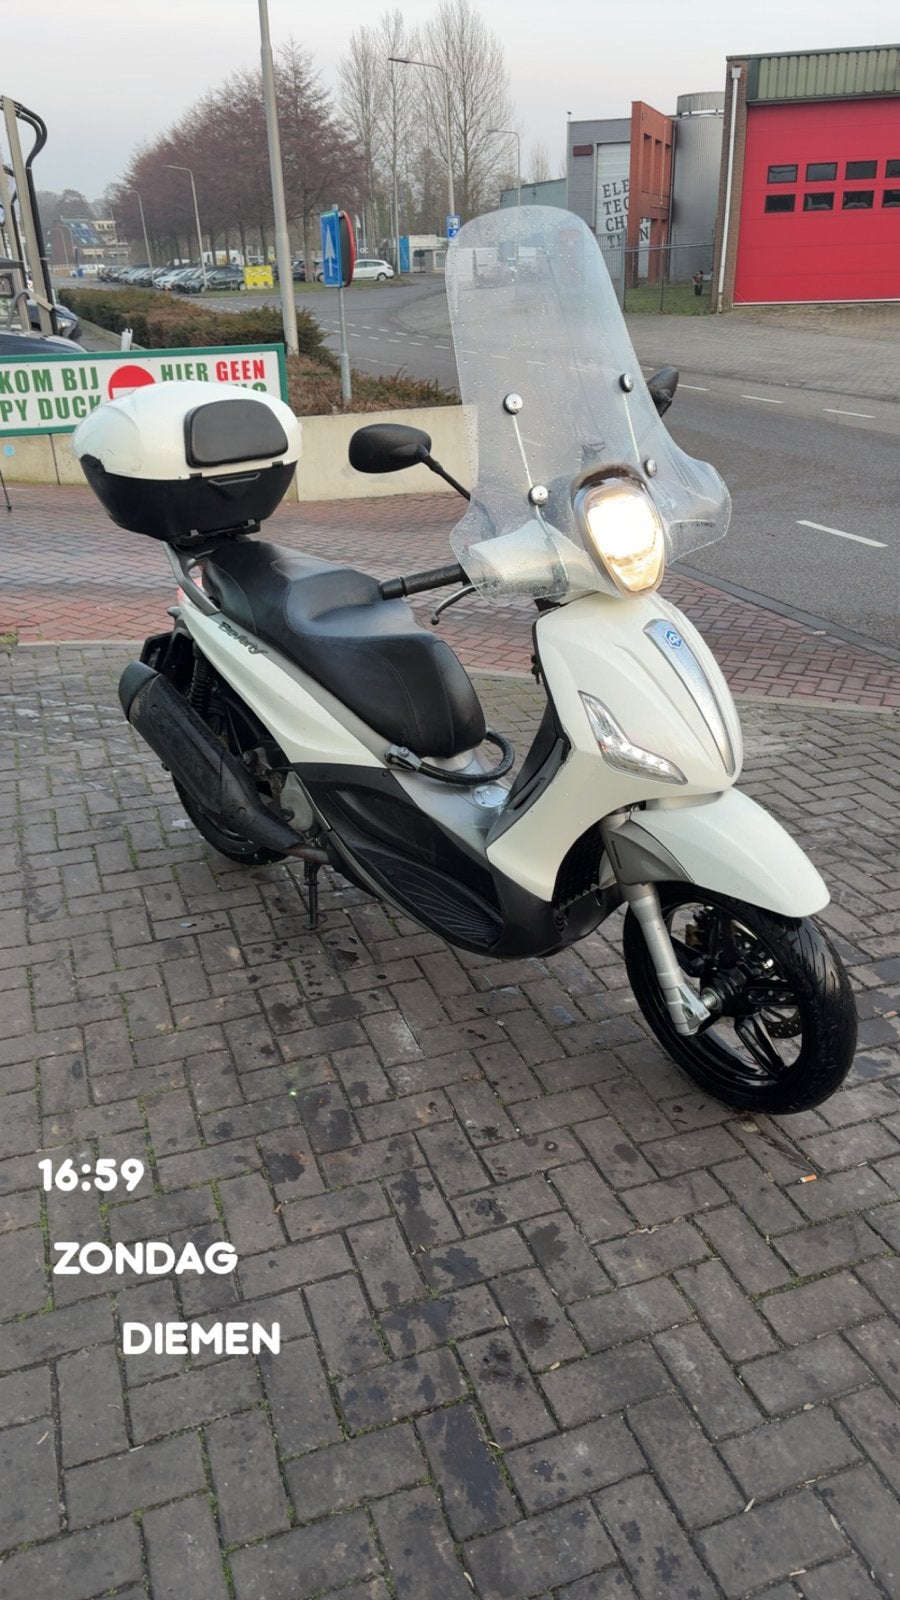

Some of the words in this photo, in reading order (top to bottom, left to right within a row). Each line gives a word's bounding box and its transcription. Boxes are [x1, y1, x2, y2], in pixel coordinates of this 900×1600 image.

[605, 214, 628, 232] CH
[0, 369, 54, 394] KOM
[61, 367, 99, 391] BIJ
[161, 363, 209, 382] HIER
[216, 360, 265, 382] GEEN
[0, 399, 27, 422] PY
